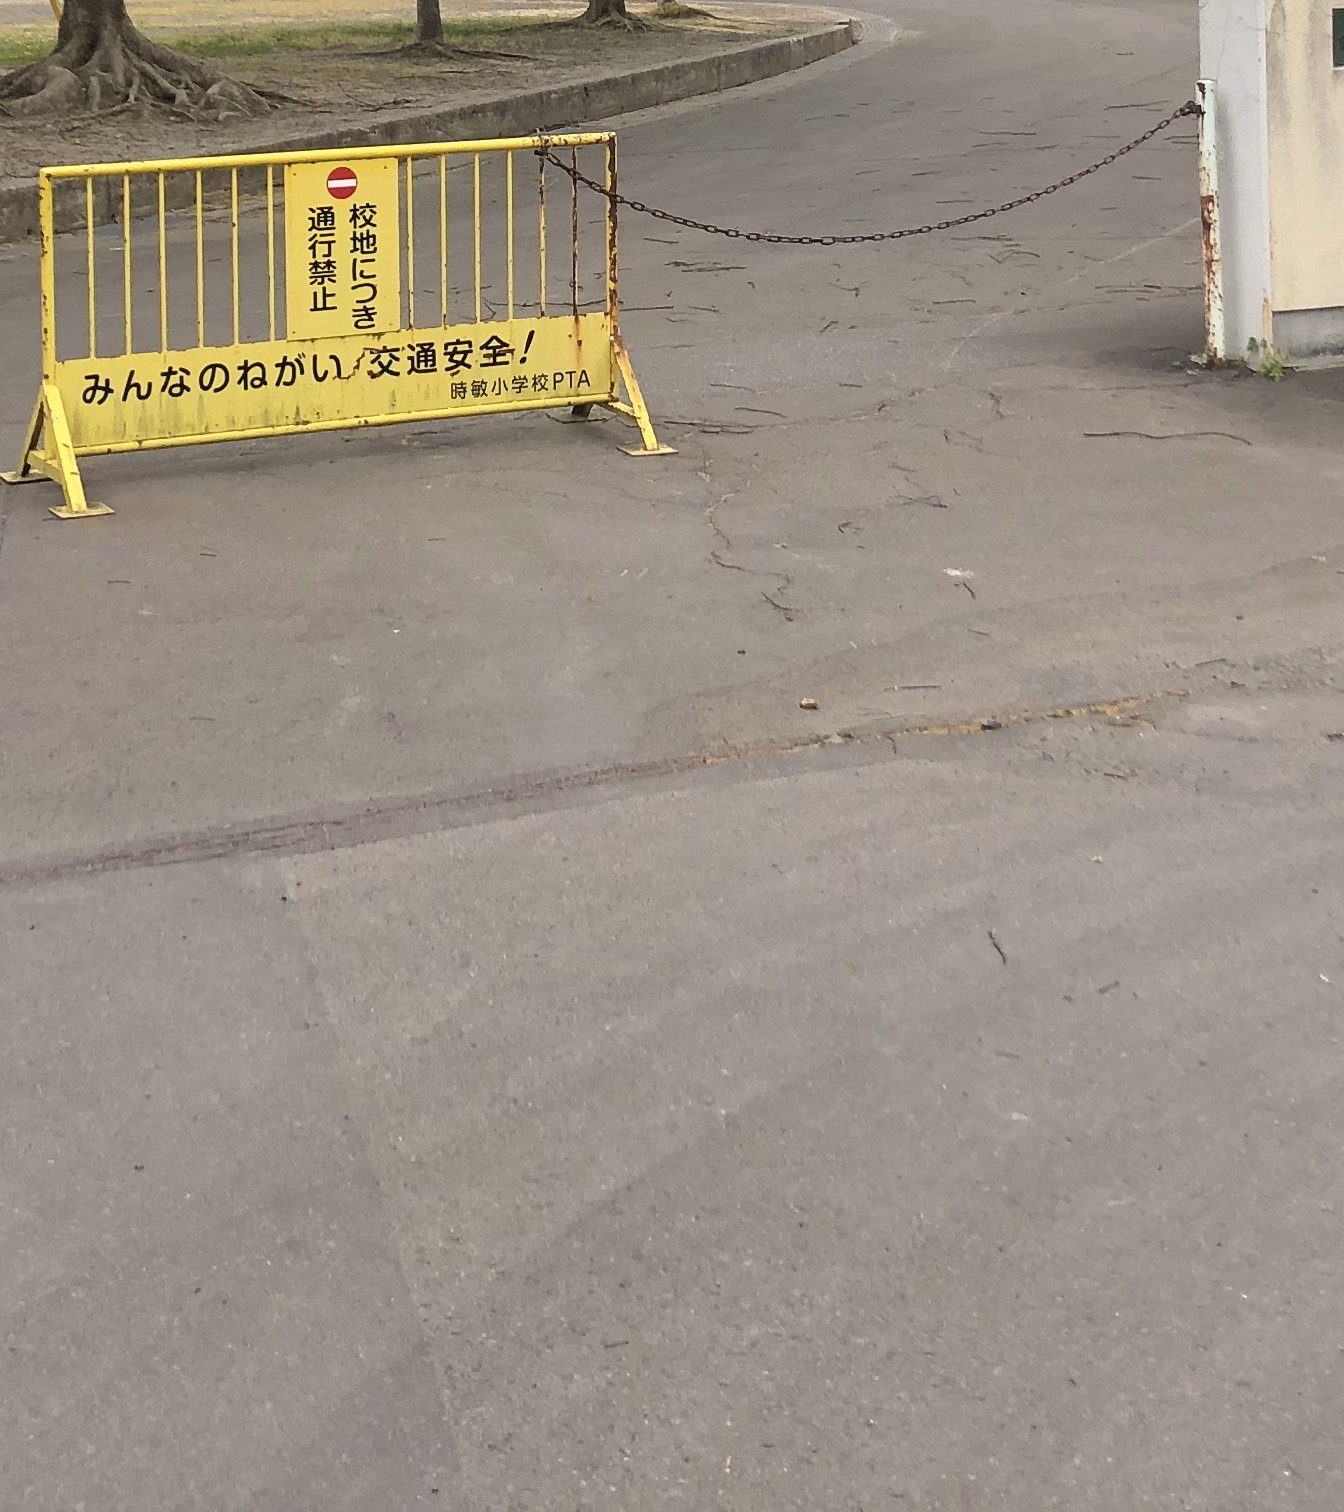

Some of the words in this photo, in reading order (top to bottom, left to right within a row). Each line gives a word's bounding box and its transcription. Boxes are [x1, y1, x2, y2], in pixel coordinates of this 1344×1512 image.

[308, 206, 337, 312] 通行禁止
[349, 203, 377, 329] 校地につき
[450, 369, 591, 400] 時敏小学校PTA
